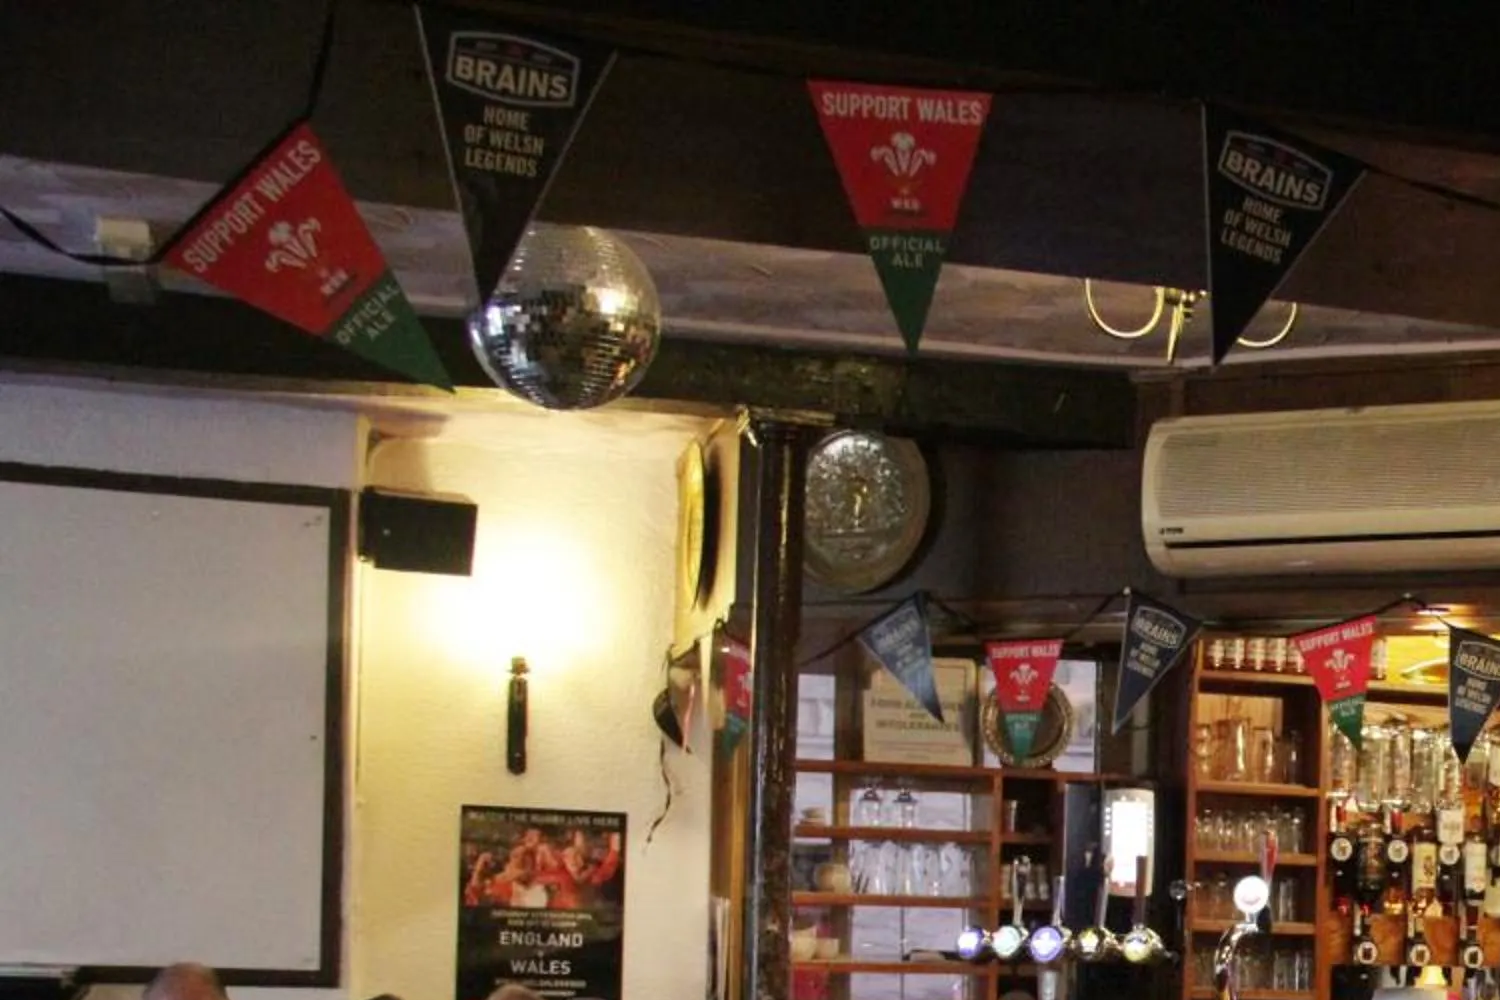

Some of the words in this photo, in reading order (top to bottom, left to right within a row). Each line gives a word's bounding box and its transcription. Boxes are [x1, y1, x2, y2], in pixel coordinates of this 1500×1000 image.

[454, 54, 569, 100] BRAINS
[483, 103, 531, 132] HOME
[821, 91, 911, 120] SUPPORT
[916, 97, 983, 126] WALES
[464, 124, 485, 144] OF
[489, 128, 545, 157] WELSH
[464, 147, 538, 178] LEGENDS
[1225, 150, 1322, 204] BRAINS
[181, 192, 266, 274] SUPPORT
[255, 139, 321, 204] WALES
[1243, 196, 1284, 225] HOME
[1223, 208, 1244, 227] OF
[1245, 215, 1292, 248] WELSH
[869, 235, 946, 254] OFFICIAL
[892, 252, 924, 269] ALE
[1220, 226, 1284, 266] LEGENDS
[336, 283, 401, 345] OFFICIAL
[366, 310, 396, 342] ALE
[499, 930, 584, 948] ENGLAND
[509, 959, 572, 975] WALES
